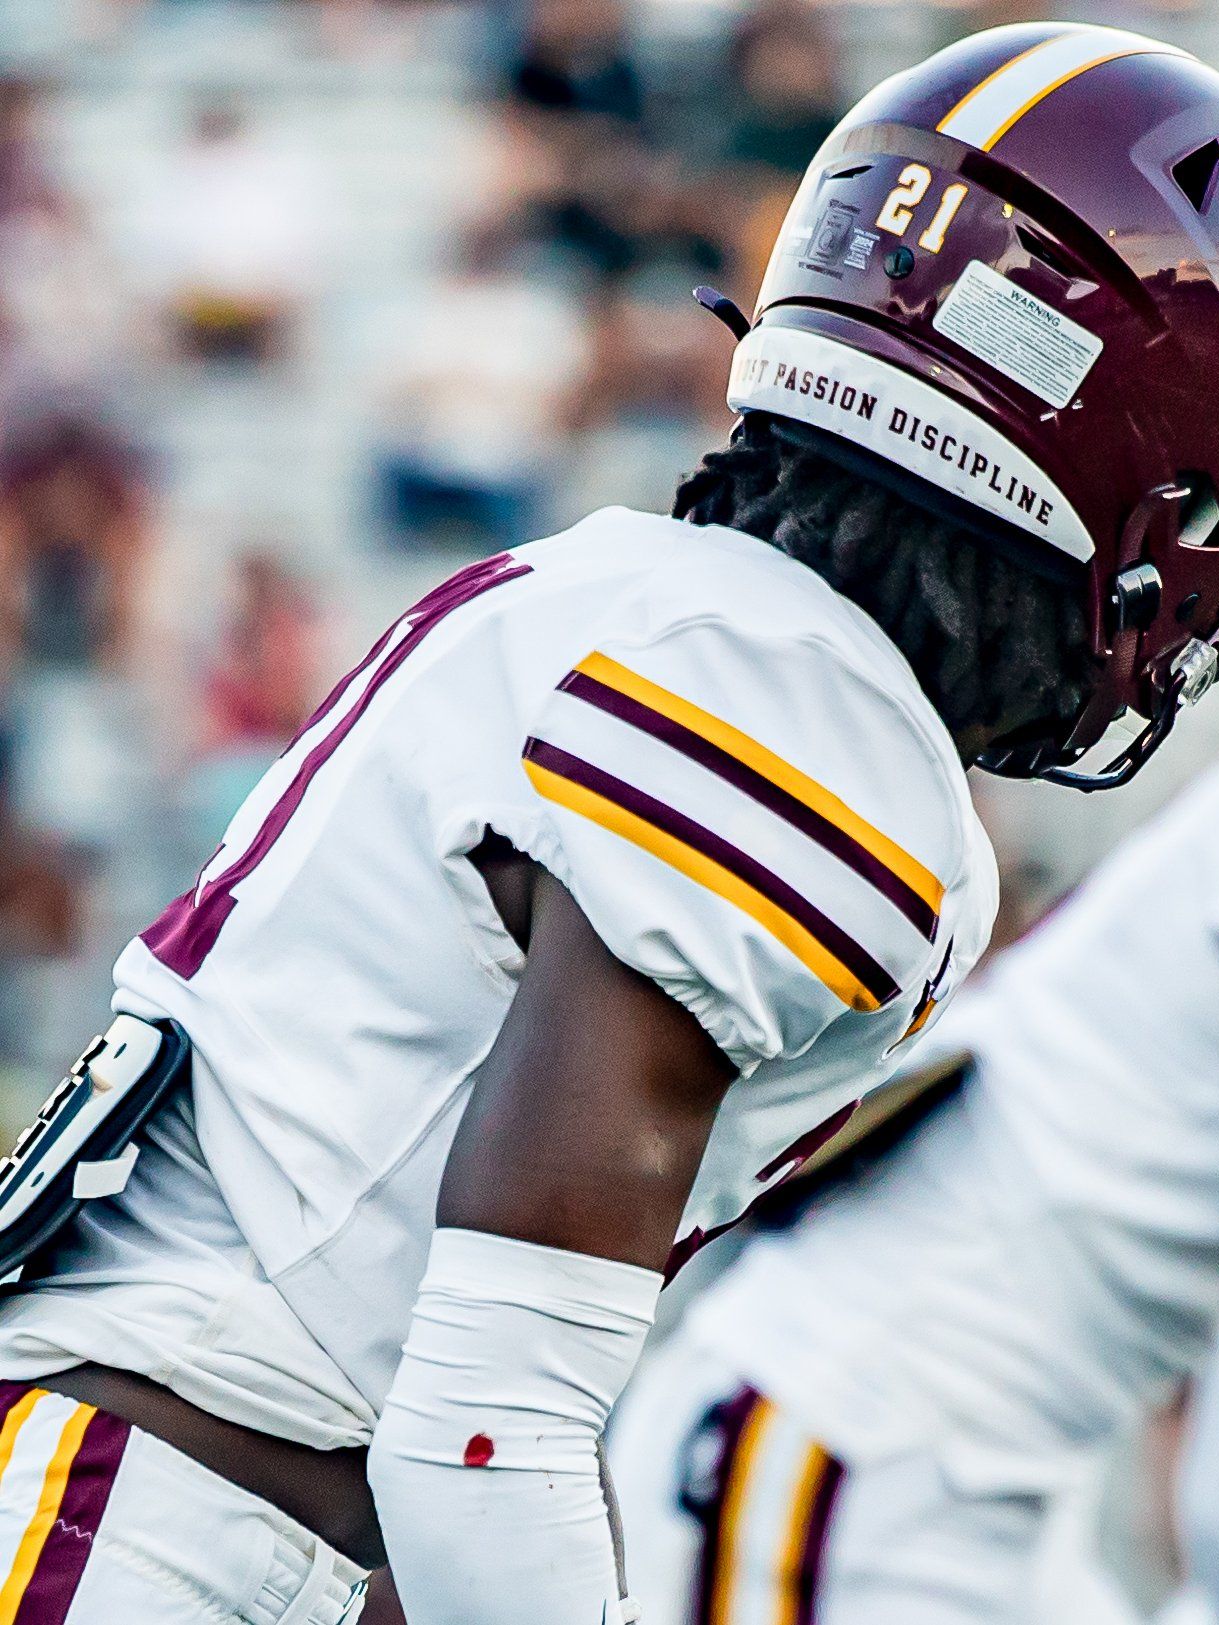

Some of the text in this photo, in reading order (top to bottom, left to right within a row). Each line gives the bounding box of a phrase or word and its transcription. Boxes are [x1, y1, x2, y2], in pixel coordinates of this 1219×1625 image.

[875, 163, 969, 254] 21
[1010, 289, 1062, 328] WARNING
[773, 362, 878, 420] PASSION
[888, 407, 1054, 526] DISCIPLINE
